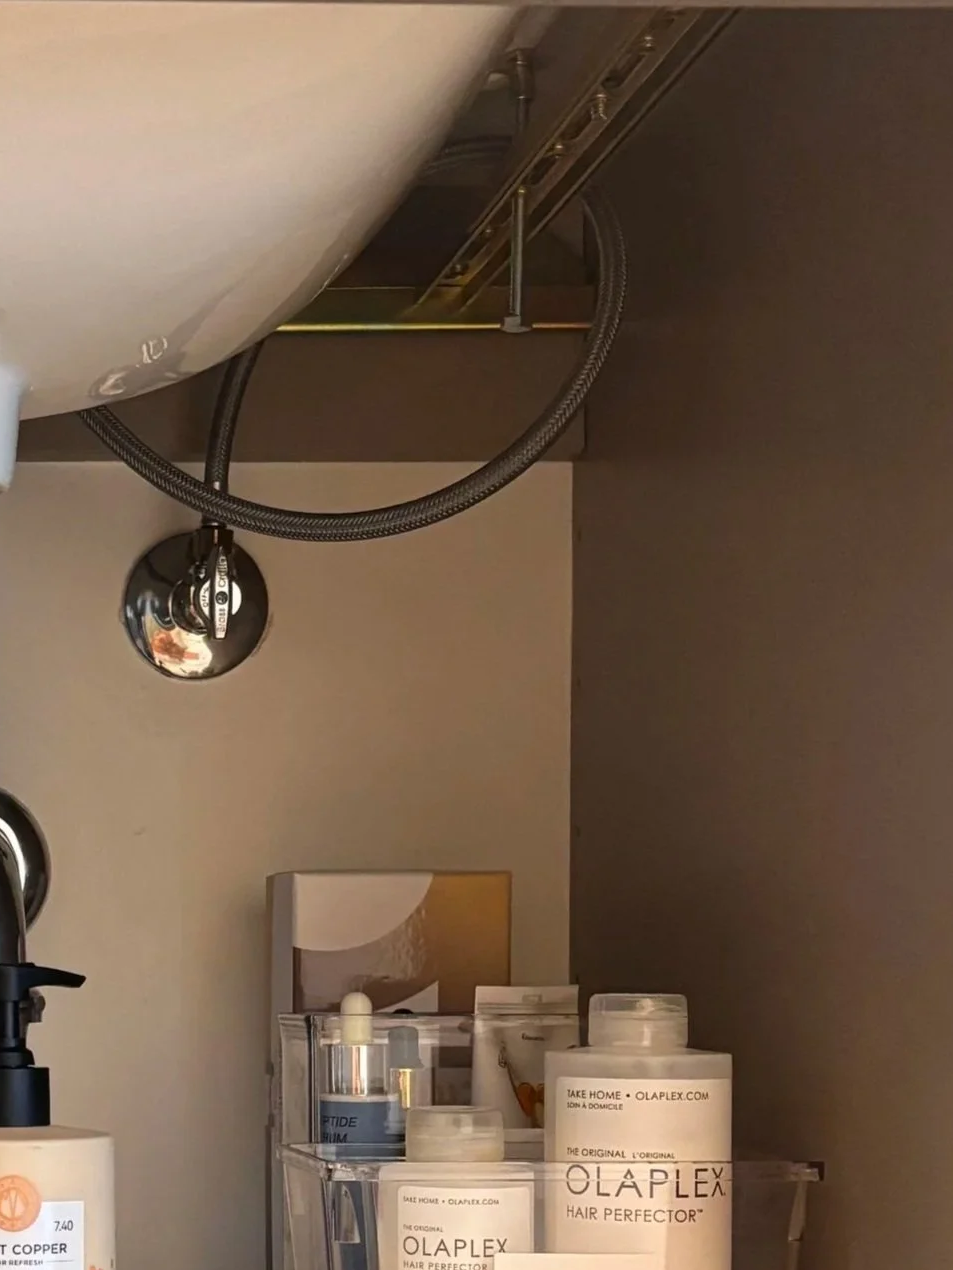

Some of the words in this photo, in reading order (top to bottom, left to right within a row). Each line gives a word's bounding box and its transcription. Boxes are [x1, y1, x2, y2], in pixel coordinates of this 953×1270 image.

[566, 1089, 587, 1100] TAKE
[589, 1090, 621, 1100] HOME
[635, 1091, 709, 1101] OLAPLEX.COM
[588, 1103, 623, 1111] DOMICILE
[566, 1147, 579, 1156] THE
[581, 1148, 626, 1158] ORIGINAL
[566, 1164, 726, 1199] OLAPLEX
[418, 1196, 439, 1205] HOME
[447, 1198, 500, 1206] OLAPLEX.COM
[566, 1205, 598, 1221] HAIR
[54, 1220, 74, 1232] 7.40
[12, 1243, 68, 1255] COPPER
[403, 1235, 508, 1258] OLAPLEX
[403, 1260, 424, 1270] HAIR
